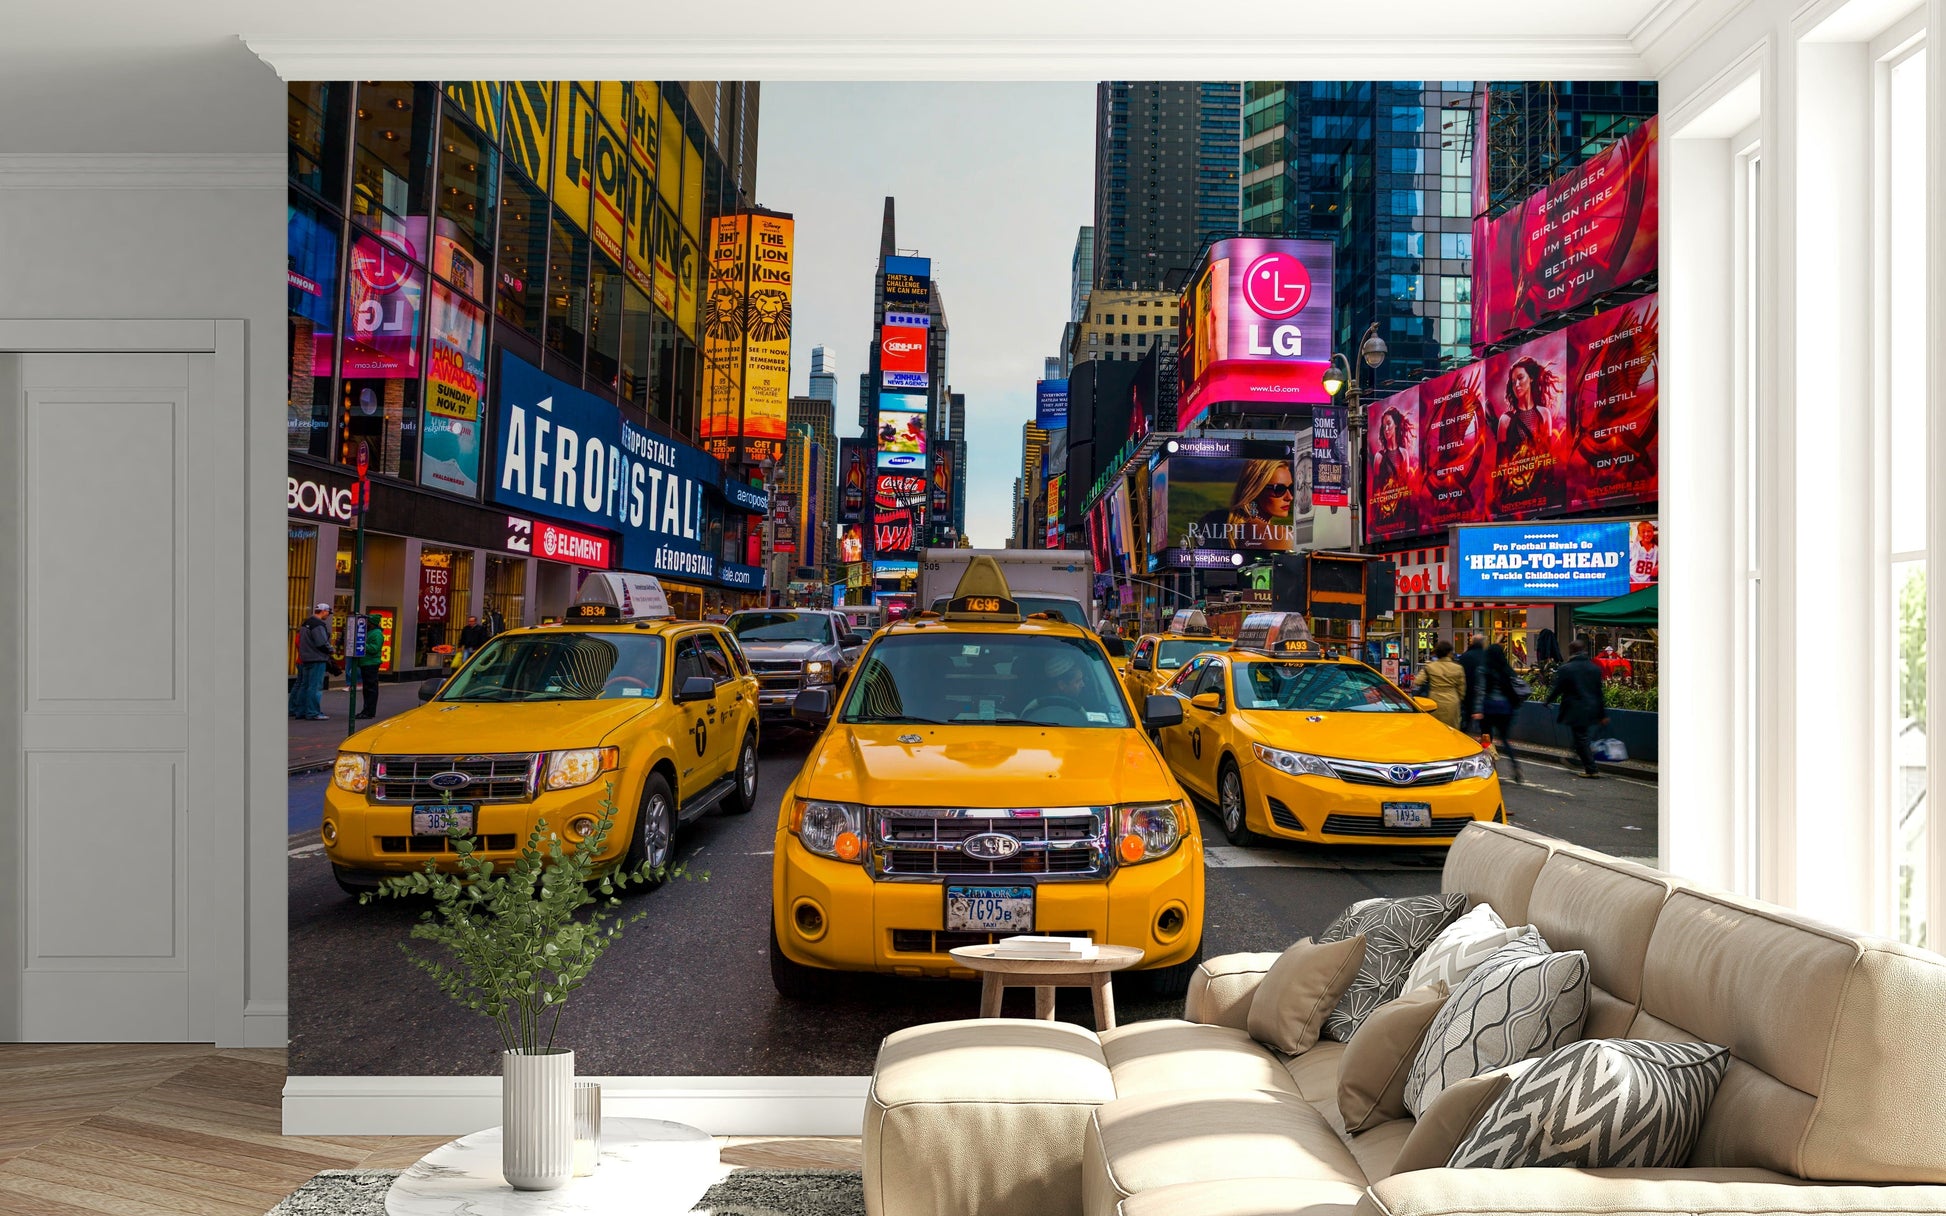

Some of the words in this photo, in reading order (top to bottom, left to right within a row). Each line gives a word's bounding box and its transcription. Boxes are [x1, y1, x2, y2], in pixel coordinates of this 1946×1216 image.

[620, 81, 657, 164] THE
[566, 83, 637, 227] LION
[1538, 167, 1605, 215] REMEMBER
[1532, 222, 1558, 241] GIRL
[1562, 207, 1580, 223] ON
[1584, 187, 1613, 209] FIRE
[638, 170, 692, 291] KING
[760, 233, 783, 245] THE
[1544, 241, 1560, 256] I'M
[1564, 220, 1600, 244] STILL
[595, 226, 622, 257] ENTRANCE
[755, 244, 788, 261] LION
[1544, 243, 1599, 278] BETTING
[752, 263, 791, 282] KING
[887, 273, 907, 281] THAT'S
[886, 280, 920, 288] CHALLENGE
[1548, 283, 1566, 299] ON
[1568, 269, 1594, 288] YOU
[1248, 324, 1303, 356] LG
[1588, 326, 1643, 351] REMEMBER
[432, 338, 464, 369] HALO
[430, 358, 478, 393] AWARDS
[757, 364, 788, 372] FOREVER.
[1584, 369, 1606, 381] GIRL
[1607, 363, 1622, 374] ON
[1624, 356, 1647, 369] FIRE
[437, 384, 471, 405] SUNDAY
[1250, 384, 1300, 393] www.LG.com
[1433, 388, 1468, 405] REMEMBER
[436, 397, 457, 412] NOV.
[458, 405, 466, 415] 17
[1594, 398, 1606, 408] I'M
[1608, 391, 1637, 404] STILL
[1315, 418, 1335, 428] SOME
[1431, 422, 1445, 430] GIRL
[1446, 416, 1456, 425] ON
[1457, 412, 1471, 422] FIRE
[1314, 429, 1338, 438] WALLS
[1594, 422, 1637, 439] BETTING
[622, 420, 676, 468] AÉROPOSTALE
[754, 440, 771, 448] GET
[1180, 443, 1215, 452] sunglass
[1216, 443, 1230, 451] hut
[1314, 438, 1329, 448] CAN
[1437, 444, 1446, 452] I'M
[1446, 440, 1464, 450] STILL
[1314, 448, 1332, 458] TALK
[1596, 459, 1611, 468] ON
[1612, 454, 1634, 464] YOU
[1437, 464, 1464, 476] BETTING
[1491, 463, 1535, 478] CATCHING
[1537, 457, 1558, 468] FIRE
[1438, 492, 1448, 500] ON
[1448, 490, 1463, 498] YOU
[1188, 522, 1246, 540] RALPH
[1252, 523, 1295, 541] LAUR
[557, 532, 602, 562] ELEMENT
[1493, 543, 1508, 551] Pro
[1510, 542, 1546, 551] Football
[1549, 541, 1578, 550] Rivals
[1580, 541, 1593, 549] Go
[655, 543, 713, 576] AÉROPOSTALE
[924, 563, 940, 571] 505
[1195, 554, 1231, 563] sunglass
[1635, 560, 1653, 574] 88
[425, 569, 447, 585] TEES
[1492, 572, 1522, 580] Tackle
[1525, 571, 1570, 580] Childhood
[1572, 571, 1606, 579] Cancer
[424, 595, 446, 617] $33
[580, 606, 606, 616] 3B34
[967, 598, 1000, 612] 7G95
[1284, 641, 1307, 651] 1A93
[968, 889, 988, 898] NEW
[989, 889, 1012, 898] YORK
